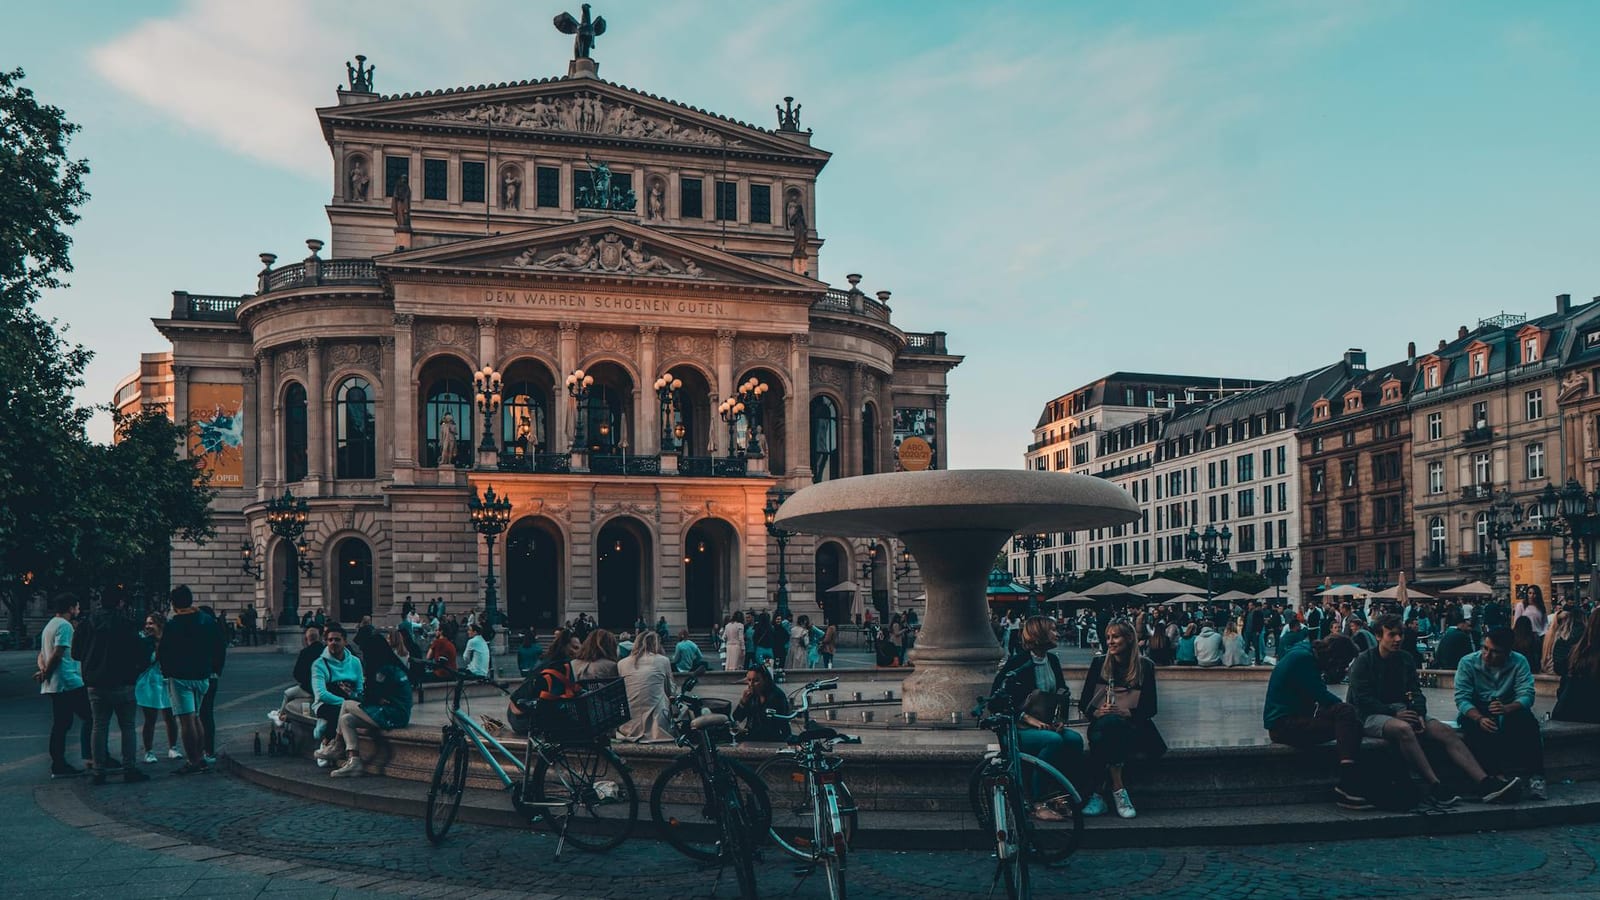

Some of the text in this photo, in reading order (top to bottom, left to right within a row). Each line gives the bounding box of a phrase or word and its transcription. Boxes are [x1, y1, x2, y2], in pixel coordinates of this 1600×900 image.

[485, 291, 516, 304] DEM
[523, 293, 586, 307] WAHREN
[594, 296, 670, 312] SCHOENEN
[216, 474, 240, 482] OPER
